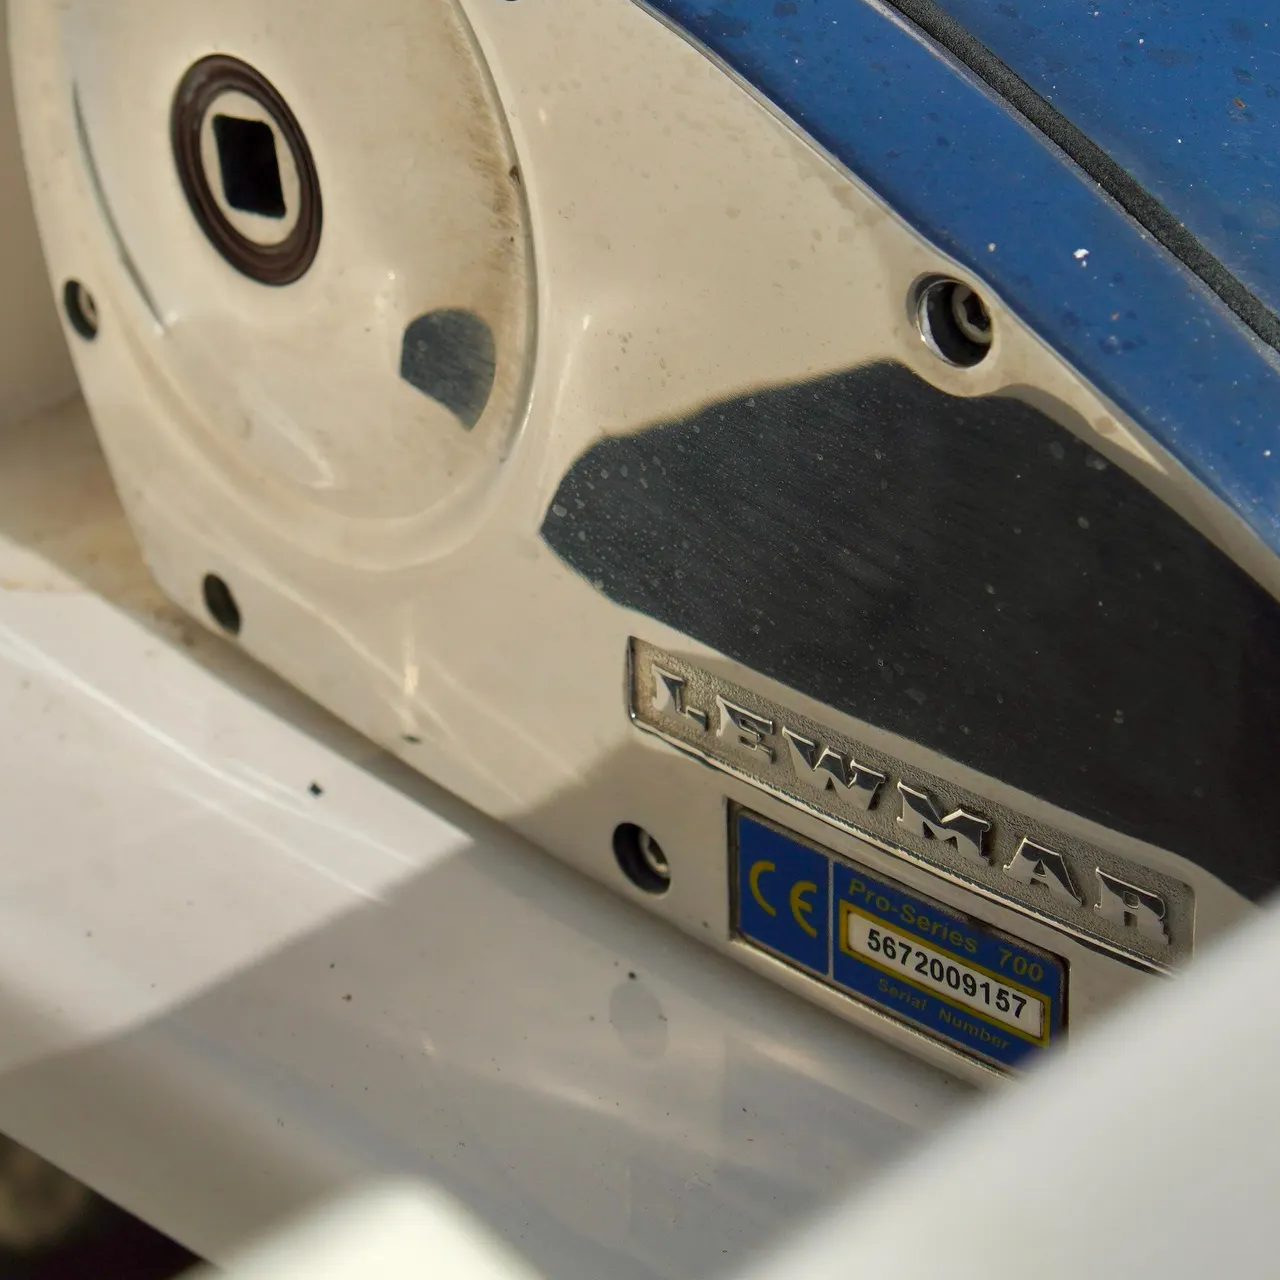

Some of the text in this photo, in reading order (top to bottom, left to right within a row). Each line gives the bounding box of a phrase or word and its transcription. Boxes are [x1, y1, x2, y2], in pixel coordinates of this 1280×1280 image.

[651, 666, 1171, 944] LEWMAR
[749, 860, 818, 936] CE
[849, 878, 1044, 983] Pro-Series 700
[867, 928, 1027, 1020] 5672009157
[877, 977, 1010, 1051] Serial Number
